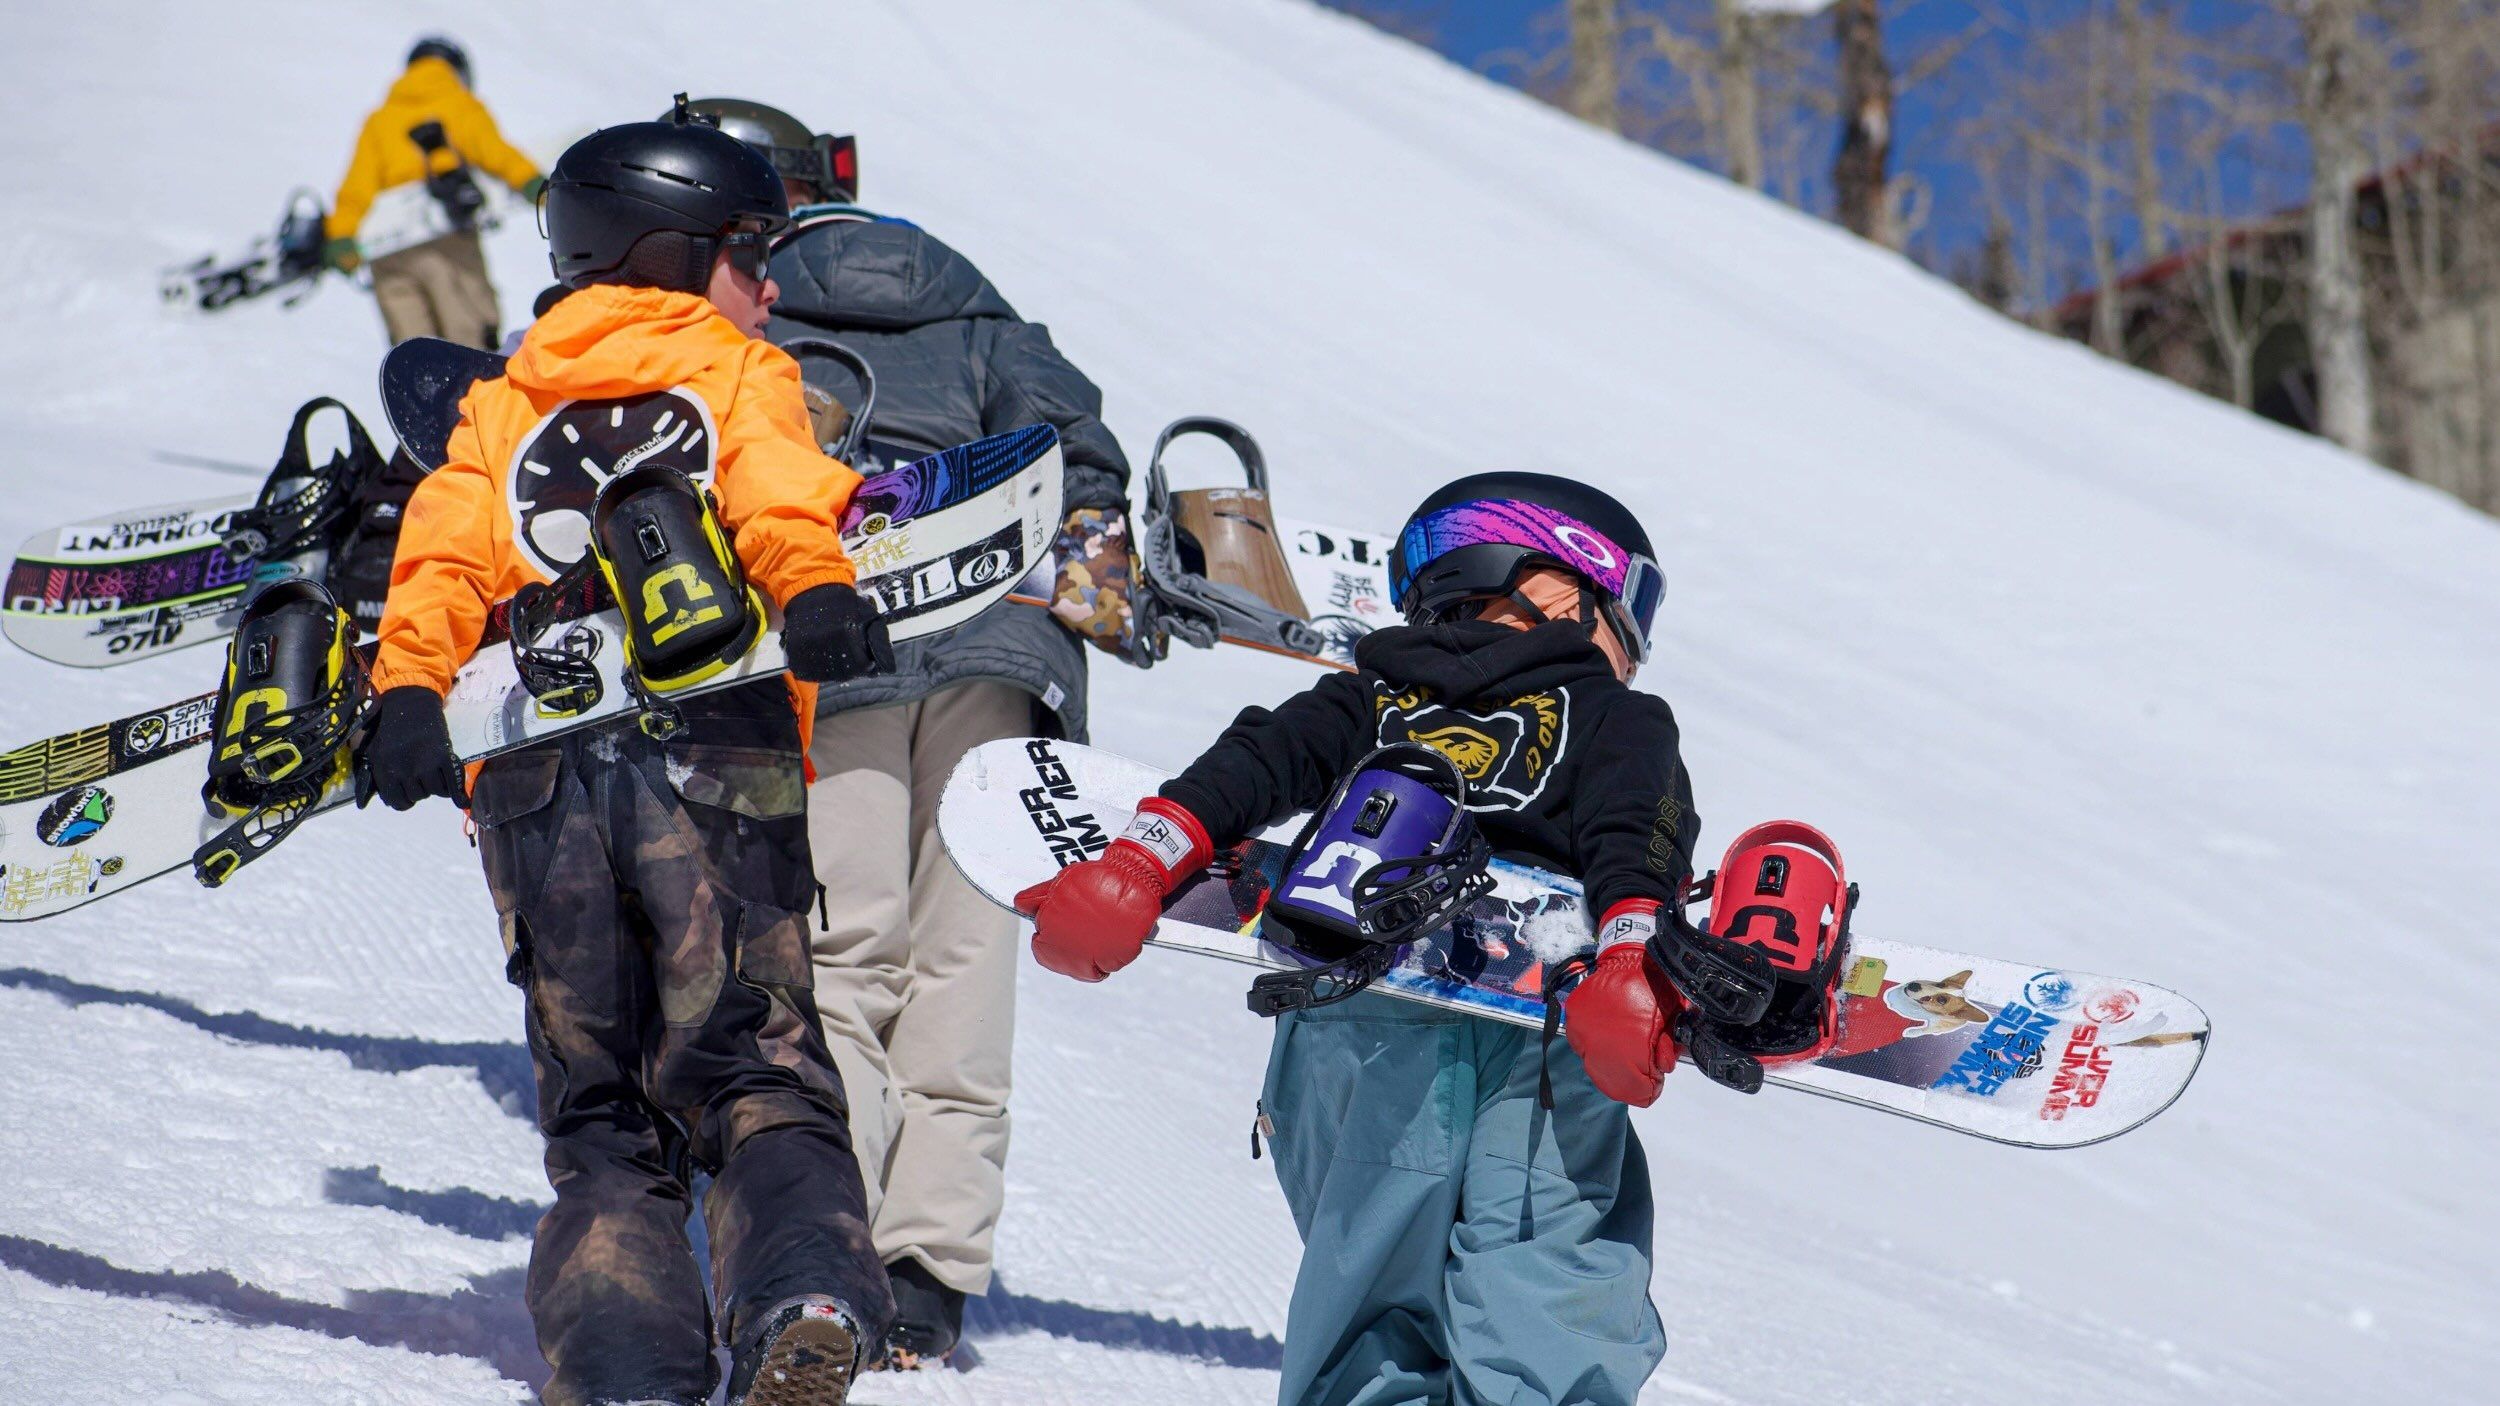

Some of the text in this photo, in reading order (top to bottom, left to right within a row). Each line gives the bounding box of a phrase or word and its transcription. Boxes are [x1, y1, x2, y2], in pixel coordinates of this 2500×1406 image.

[613, 432, 666, 473] SPACETIME
[62, 515, 228, 551] ORMENT
[169, 698, 218, 723] SPAC
[47, 787, 97, 845] snowbird
[1019, 786, 1089, 868] EVER
